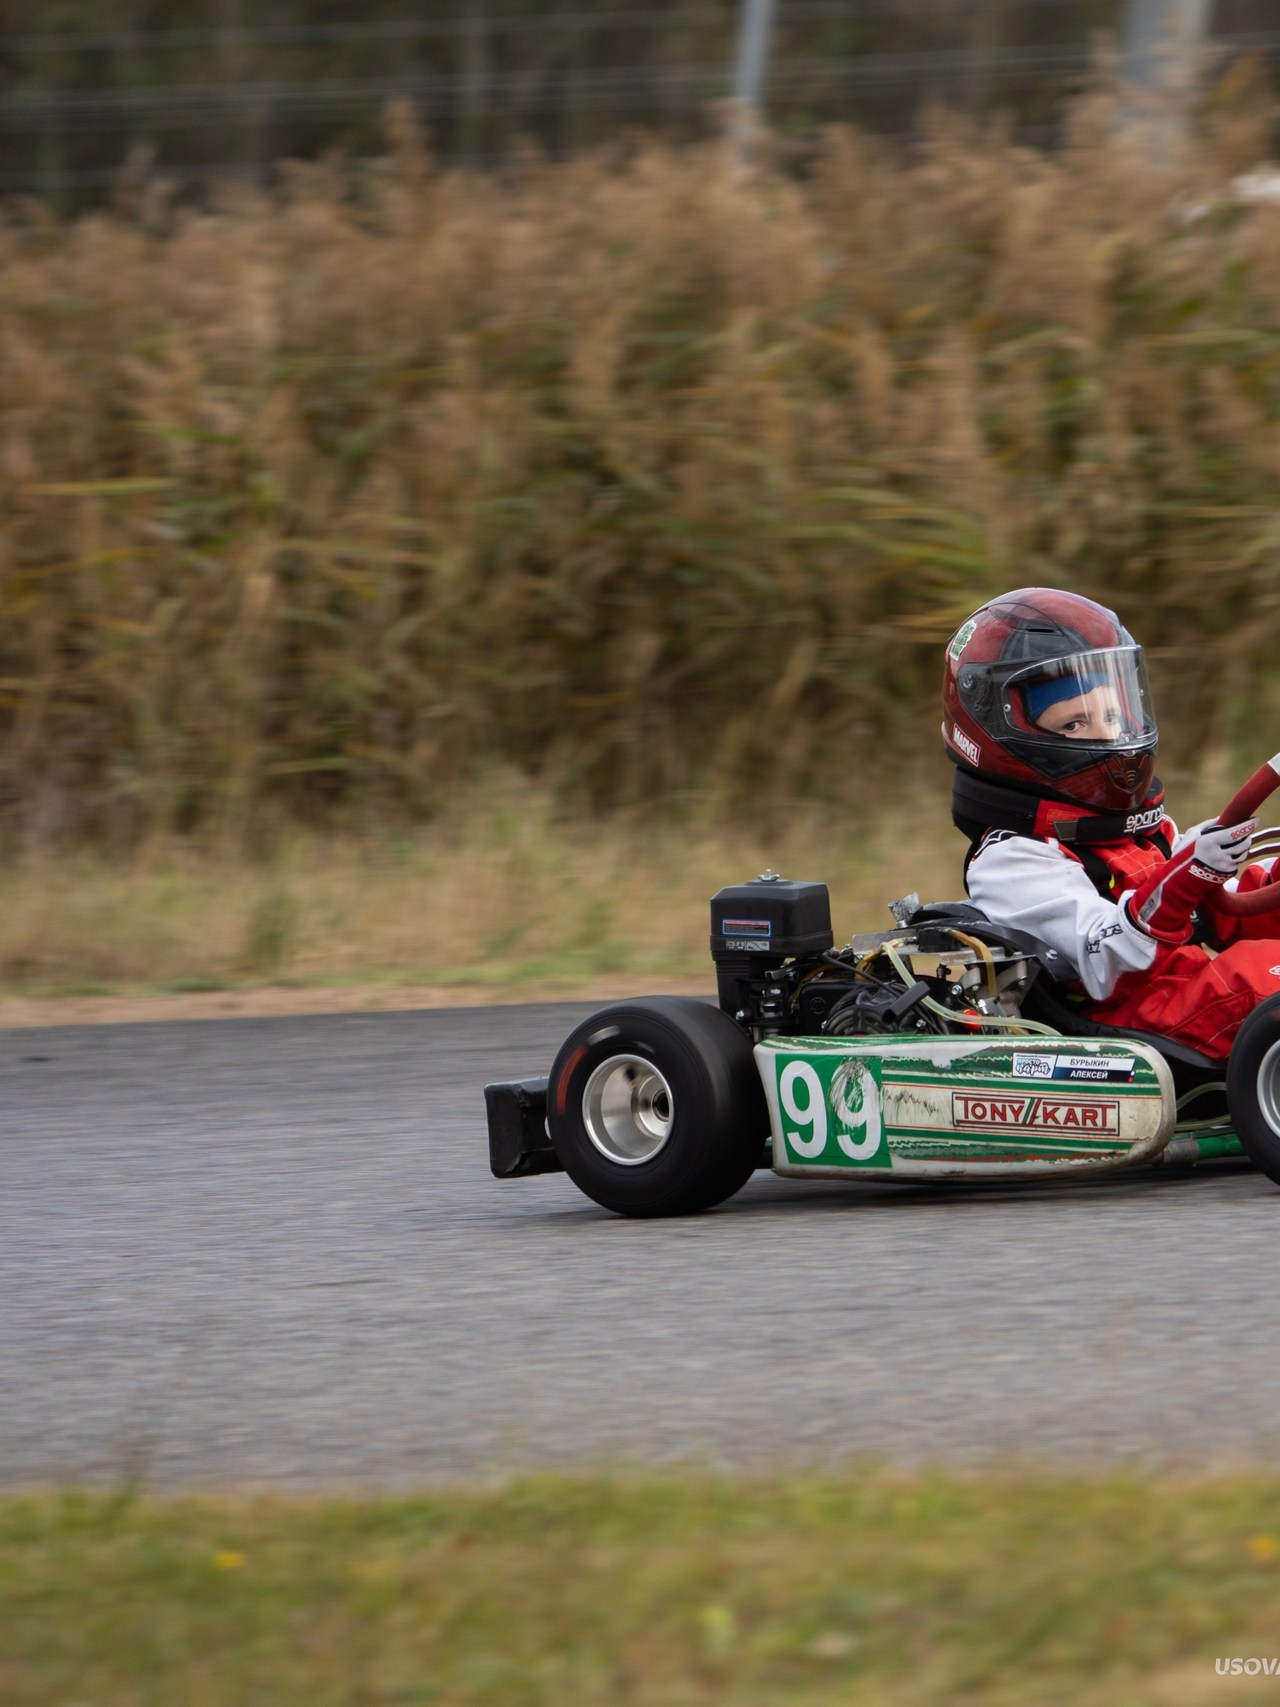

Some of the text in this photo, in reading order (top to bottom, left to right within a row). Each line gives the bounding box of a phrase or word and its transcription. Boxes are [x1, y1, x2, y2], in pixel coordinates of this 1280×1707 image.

[953, 726, 979, 764] MARVEL
[1069, 1058, 1110, 1068] БУРЫКИН
[1069, 1069, 1109, 1080] АЛЕКСЕЙ
[780, 1060, 882, 1161] 99
[1042, 1101, 1117, 1128] KART
